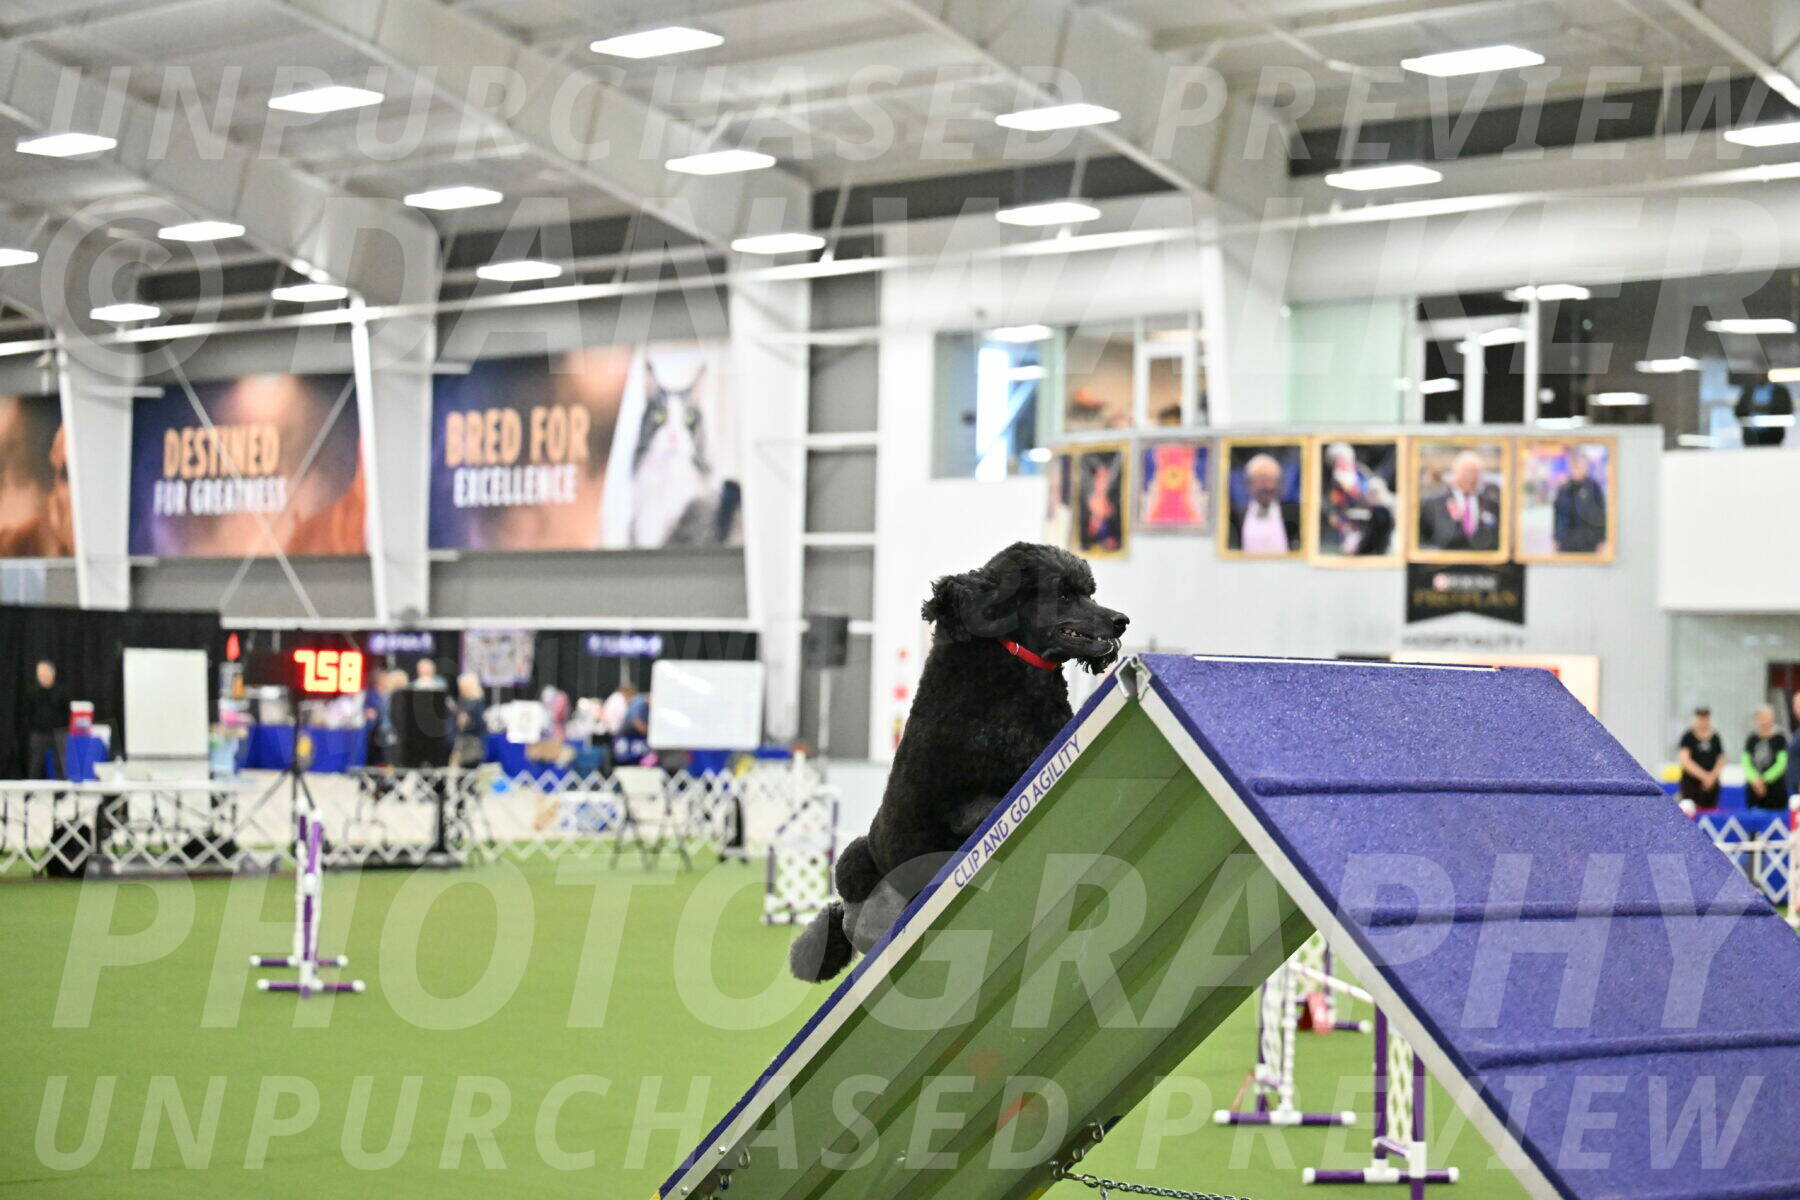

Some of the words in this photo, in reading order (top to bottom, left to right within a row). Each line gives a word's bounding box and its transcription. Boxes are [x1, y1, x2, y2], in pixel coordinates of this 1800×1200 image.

[162, 424, 282, 478] DESTINED
[445, 409, 522, 467] BRED
[529, 404, 590, 463] FOR
[453, 464, 577, 508] EXCELLENCE
[953, 849, 983, 888] CLIP
[983, 820, 1009, 859] AND
[1010, 794, 1031, 824] GO
[1032, 734, 1083, 803] AGILITY
